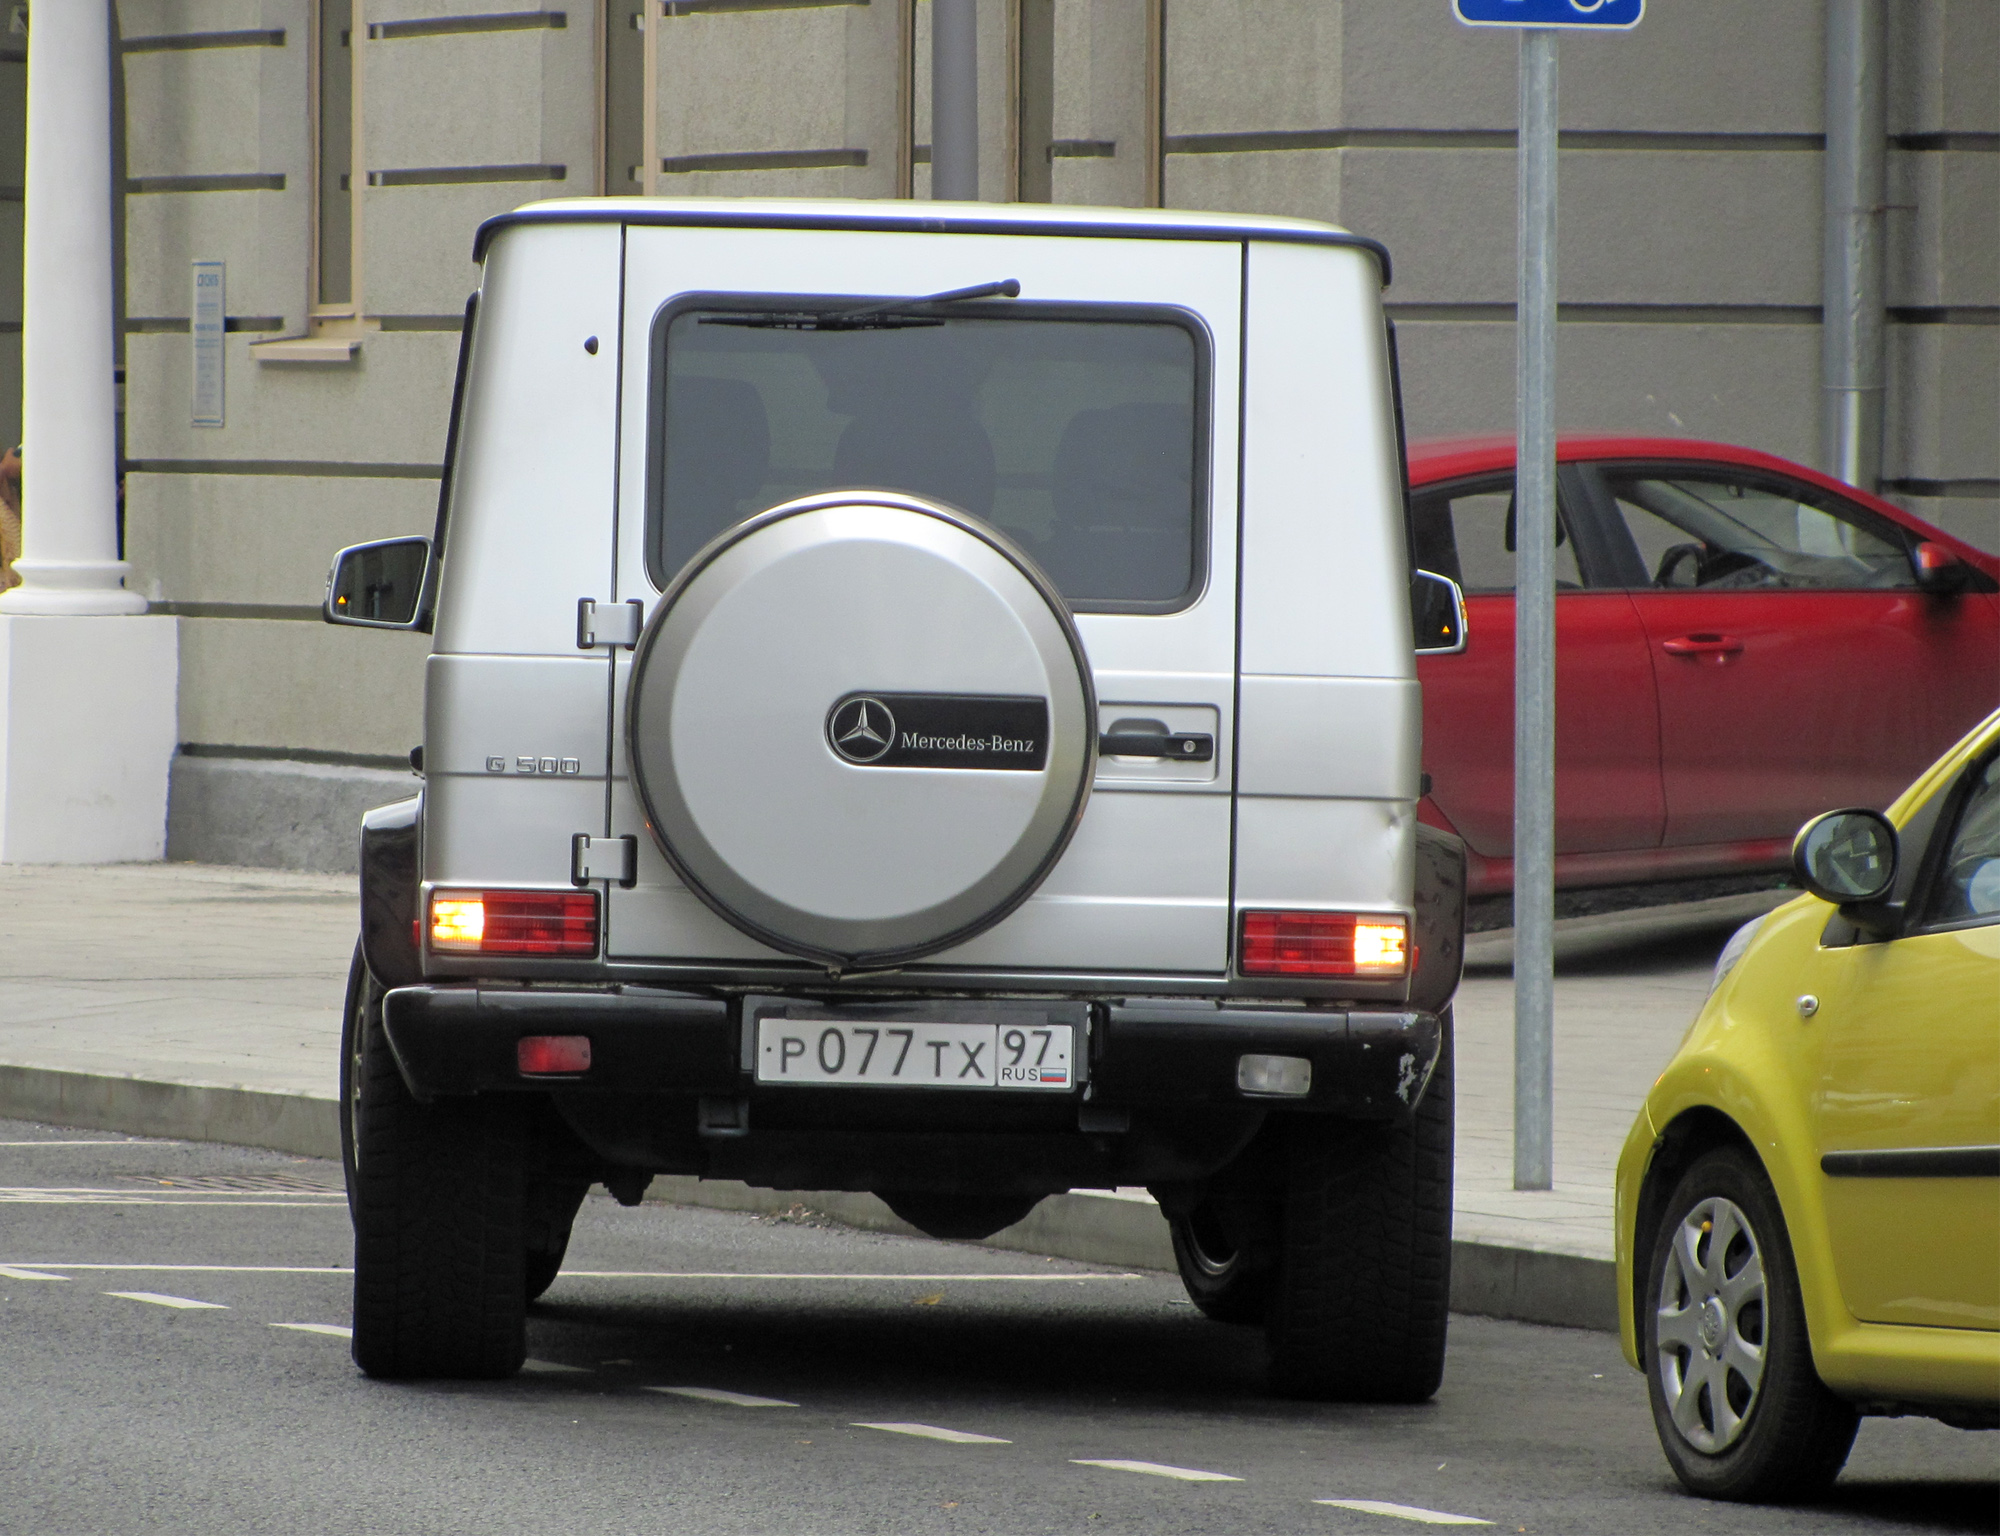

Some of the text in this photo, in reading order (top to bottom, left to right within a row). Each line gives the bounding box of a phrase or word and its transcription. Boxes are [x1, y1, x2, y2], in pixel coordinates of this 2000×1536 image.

[901, 732, 1034, 752] Mercedes-Benz
[486, 755, 580, 774] G 500
[1003, 1029, 1052, 1066] 97
[1001, 1067, 1038, 1081] RUS
